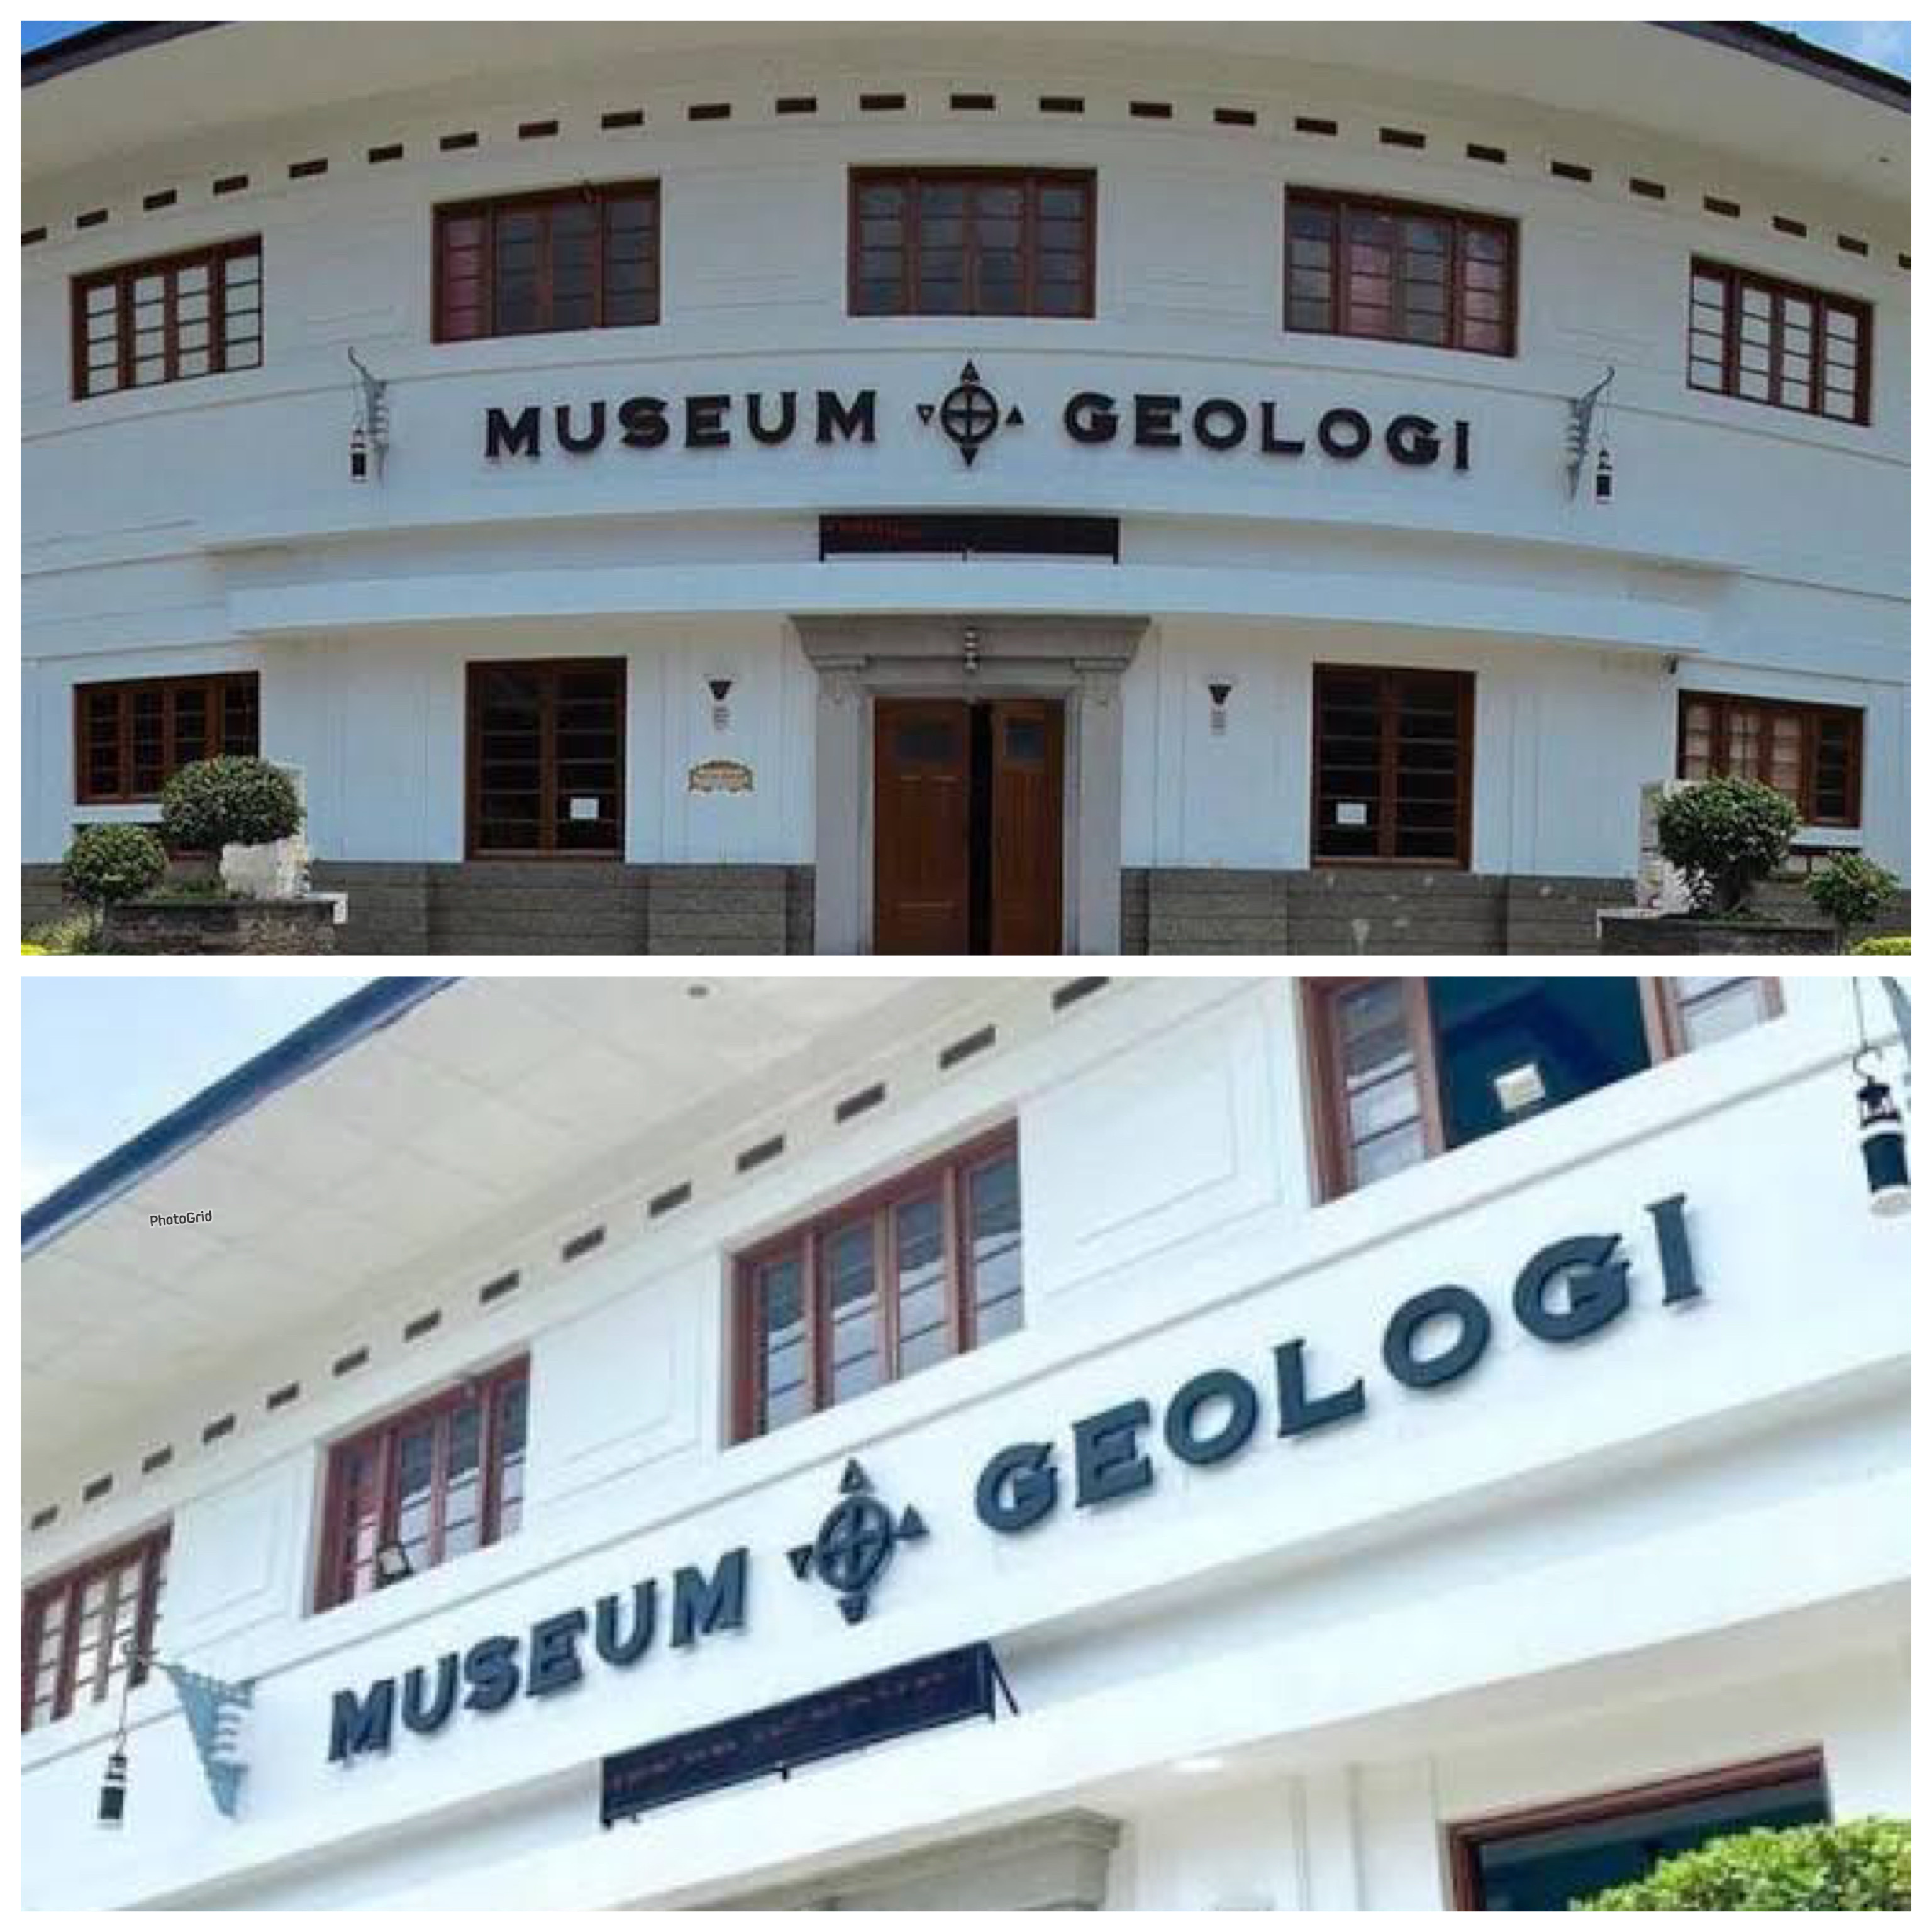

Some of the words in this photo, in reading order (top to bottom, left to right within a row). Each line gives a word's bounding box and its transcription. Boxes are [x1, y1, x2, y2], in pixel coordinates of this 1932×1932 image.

[485, 390, 877, 457] MUSEUM
[1064, 392, 1470, 470] GEOLOGI
[328, 1548, 749, 1762] MUSEUM
[975, 1194, 1702, 1533] GEOLOGI
